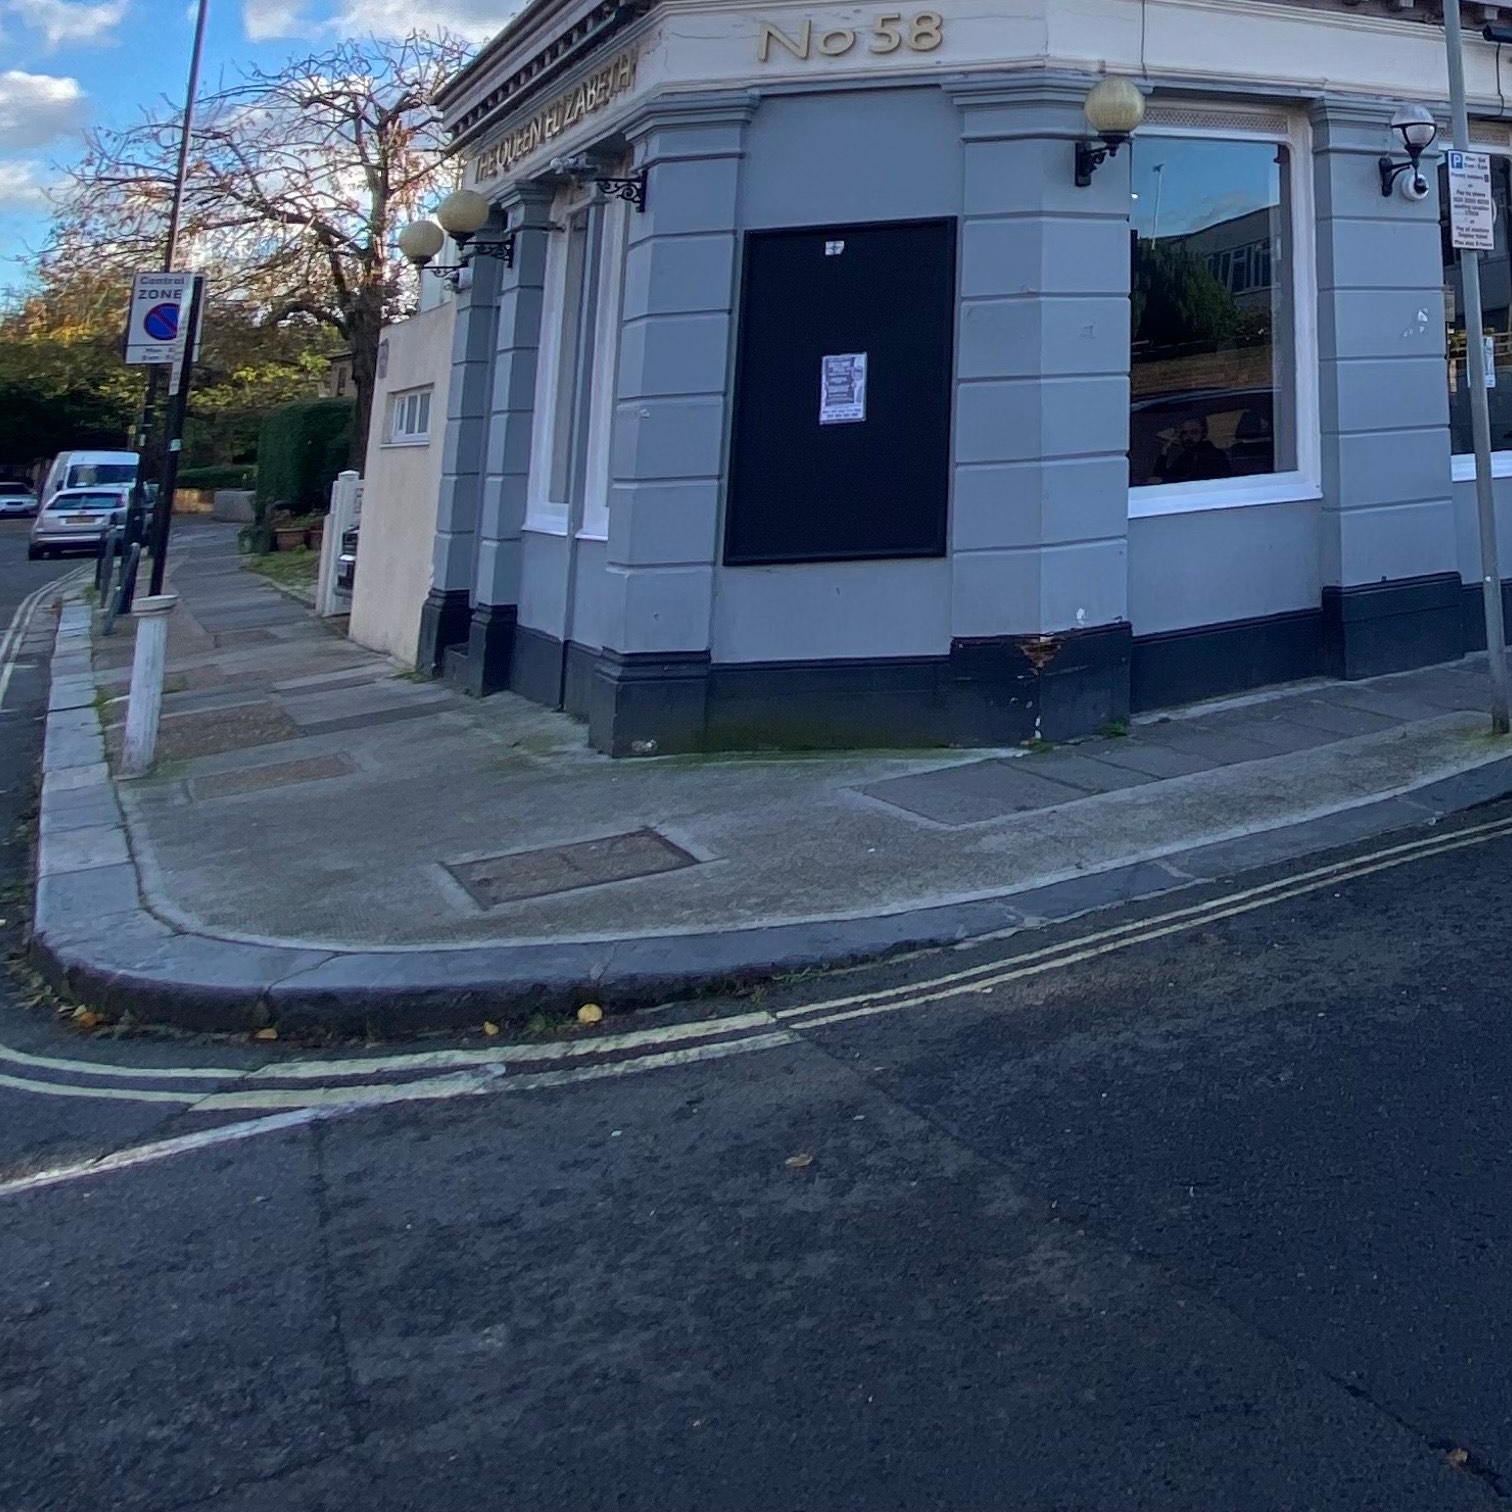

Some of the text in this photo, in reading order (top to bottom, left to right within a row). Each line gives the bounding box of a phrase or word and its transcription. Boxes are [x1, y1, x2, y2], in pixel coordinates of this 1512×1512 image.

[758, 11, 944, 63] No 58
[476, 46, 638, 184] THE QUEEN ELIZABETH
[138, 289, 183, 300] ZONE
